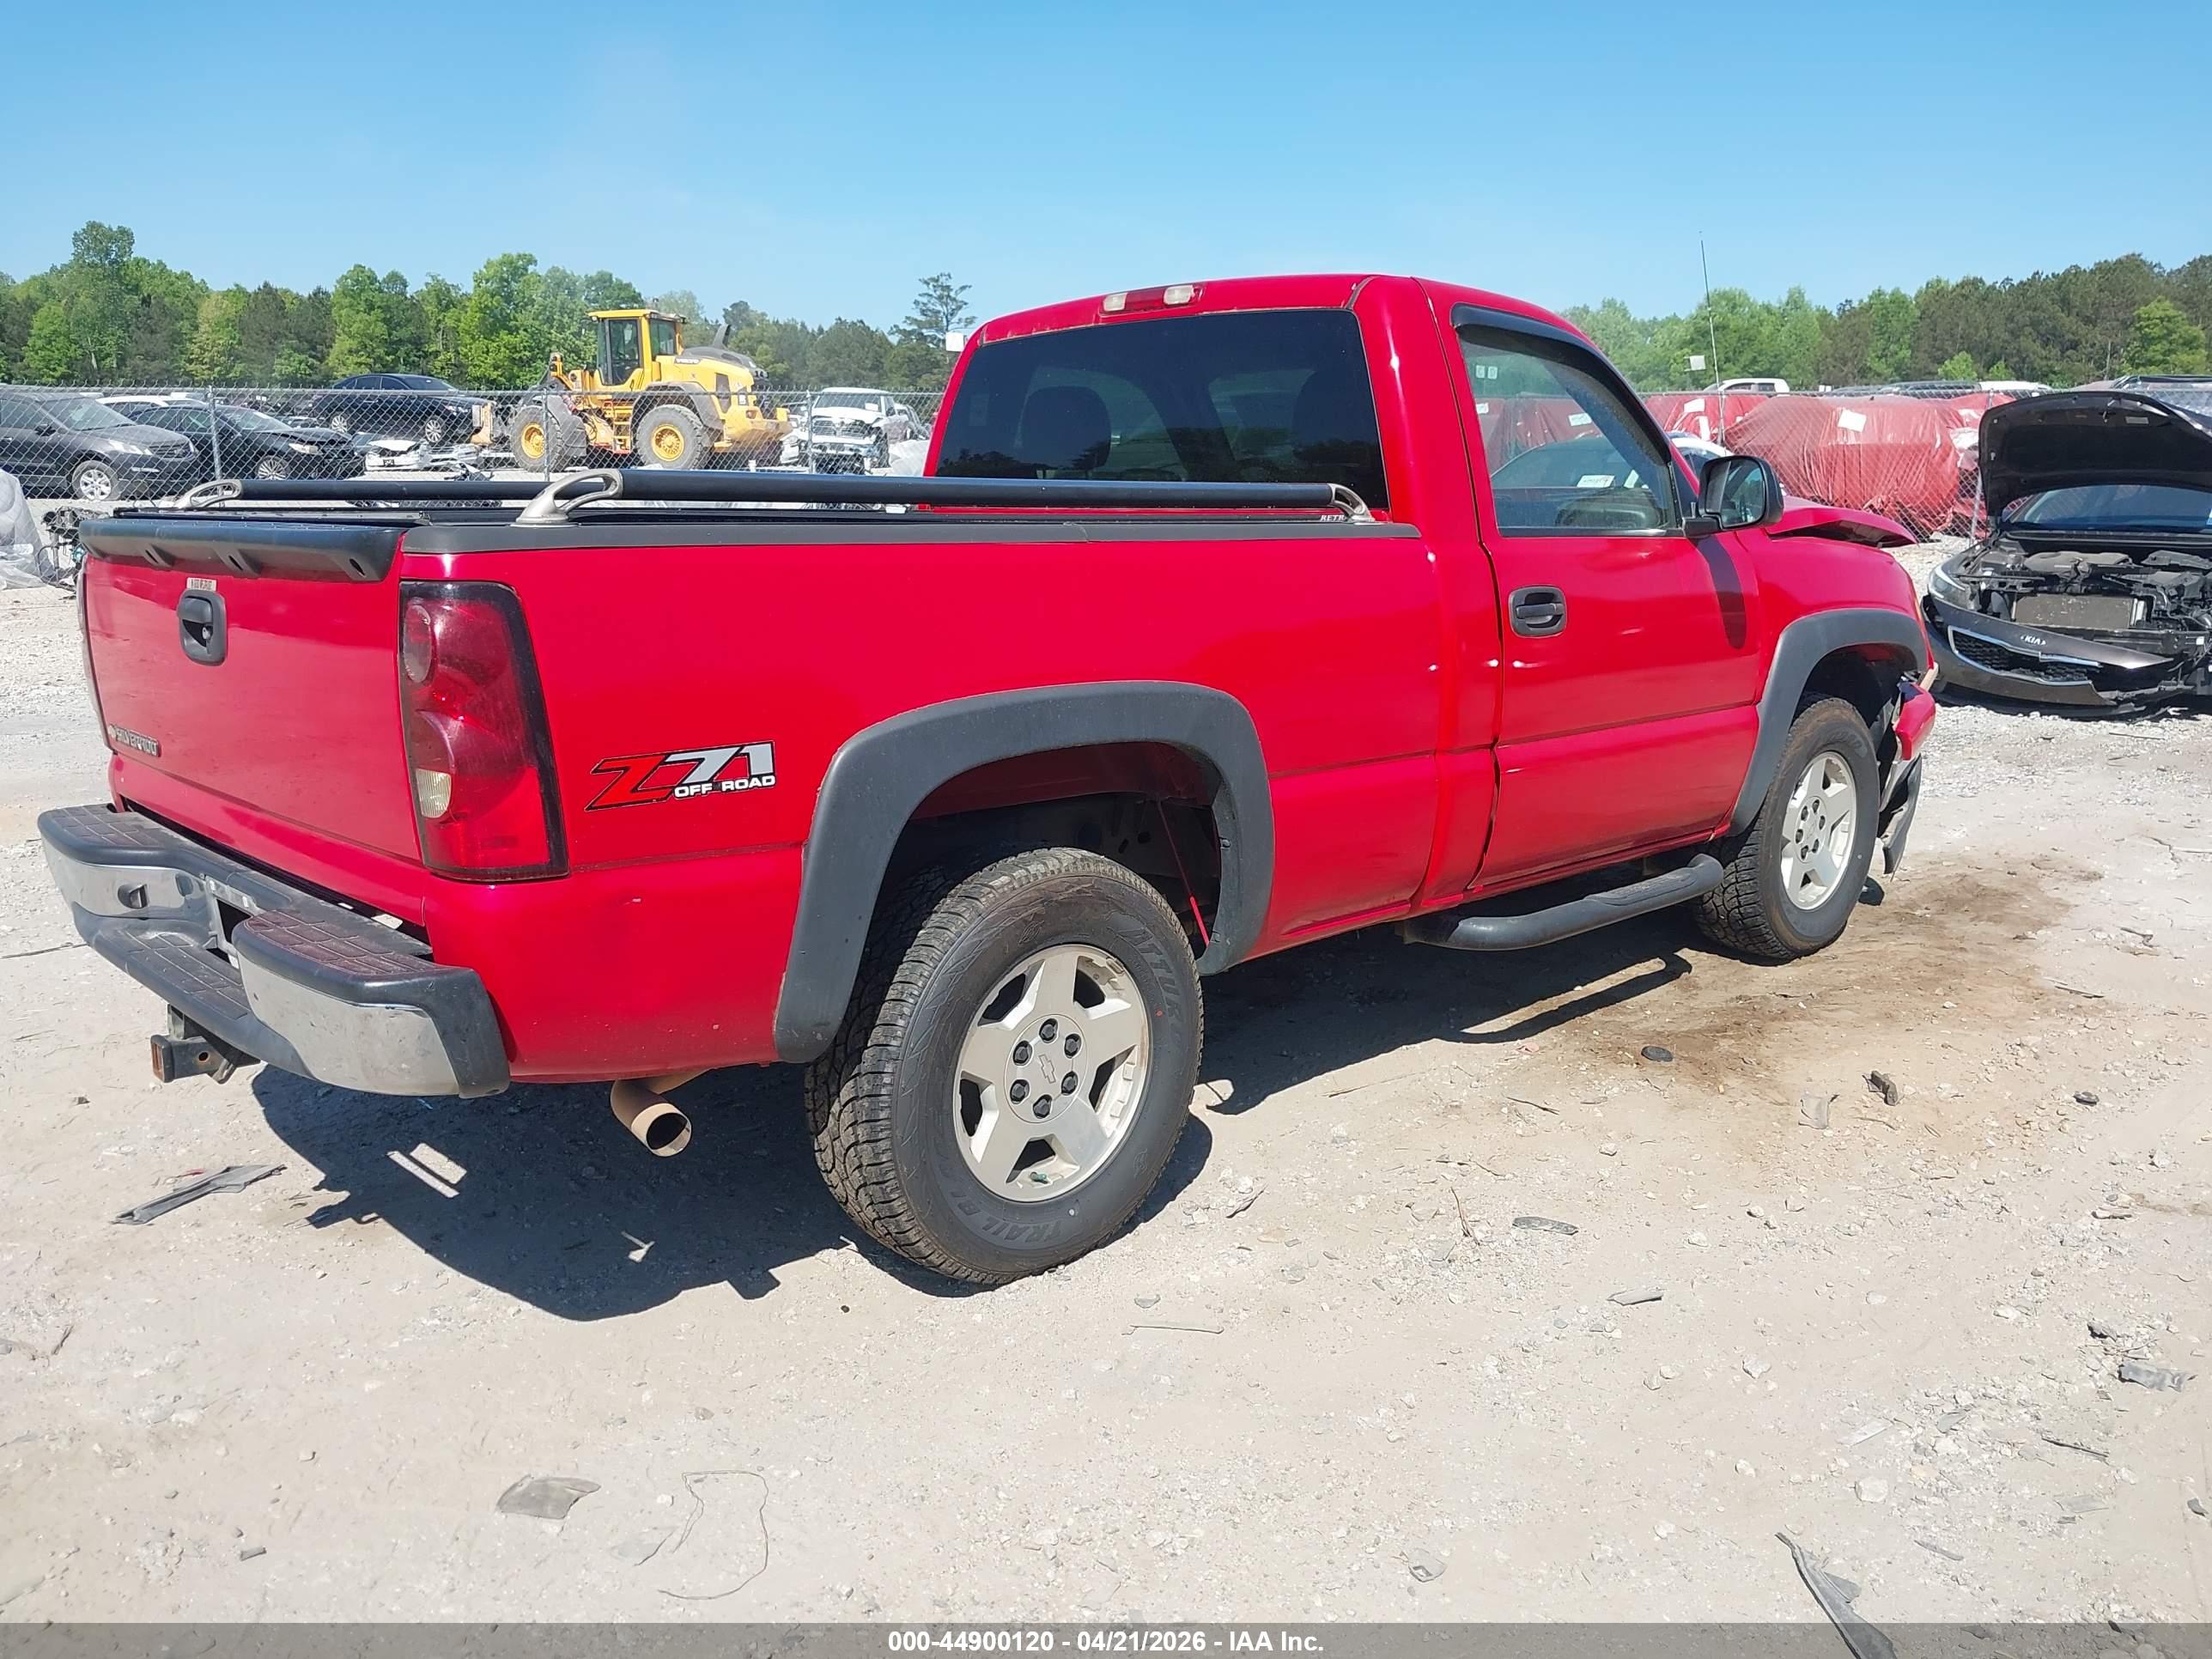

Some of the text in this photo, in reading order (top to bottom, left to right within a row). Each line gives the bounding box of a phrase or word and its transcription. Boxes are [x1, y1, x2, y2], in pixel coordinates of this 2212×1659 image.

[585, 740, 775, 811] Z71
[673, 775, 776, 799] OFF ROAD
